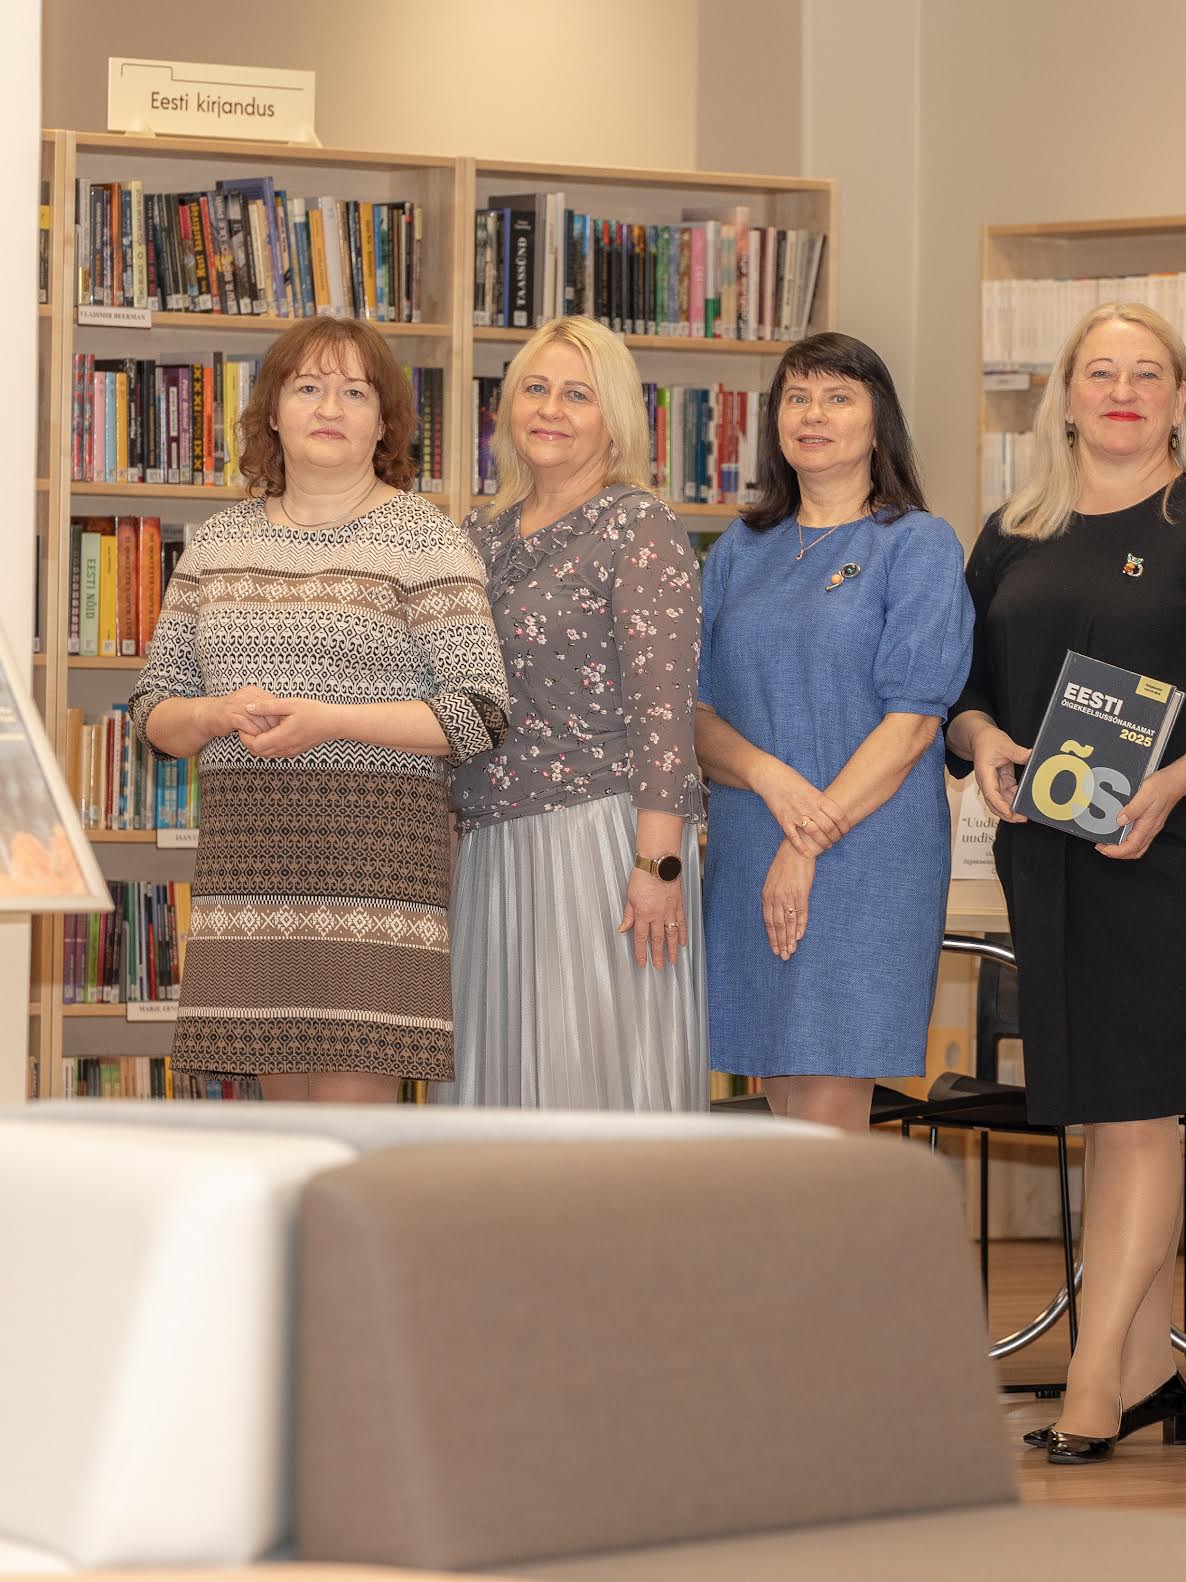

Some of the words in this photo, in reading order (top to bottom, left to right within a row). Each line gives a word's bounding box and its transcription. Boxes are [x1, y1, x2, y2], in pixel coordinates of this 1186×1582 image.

[151, 92, 188, 110] Eesti
[196, 92, 275, 118] kirjandus
[516, 237, 527, 306] TAASSÜND
[86, 558, 95, 590] EESTI
[86, 593, 97, 619] NÕID
[1064, 682, 1124, 716] EESTI
[1061, 699, 1156, 736] ÕIGEKEELSUSSÕNARAAMAT
[1120, 728, 1152, 748] 2025
